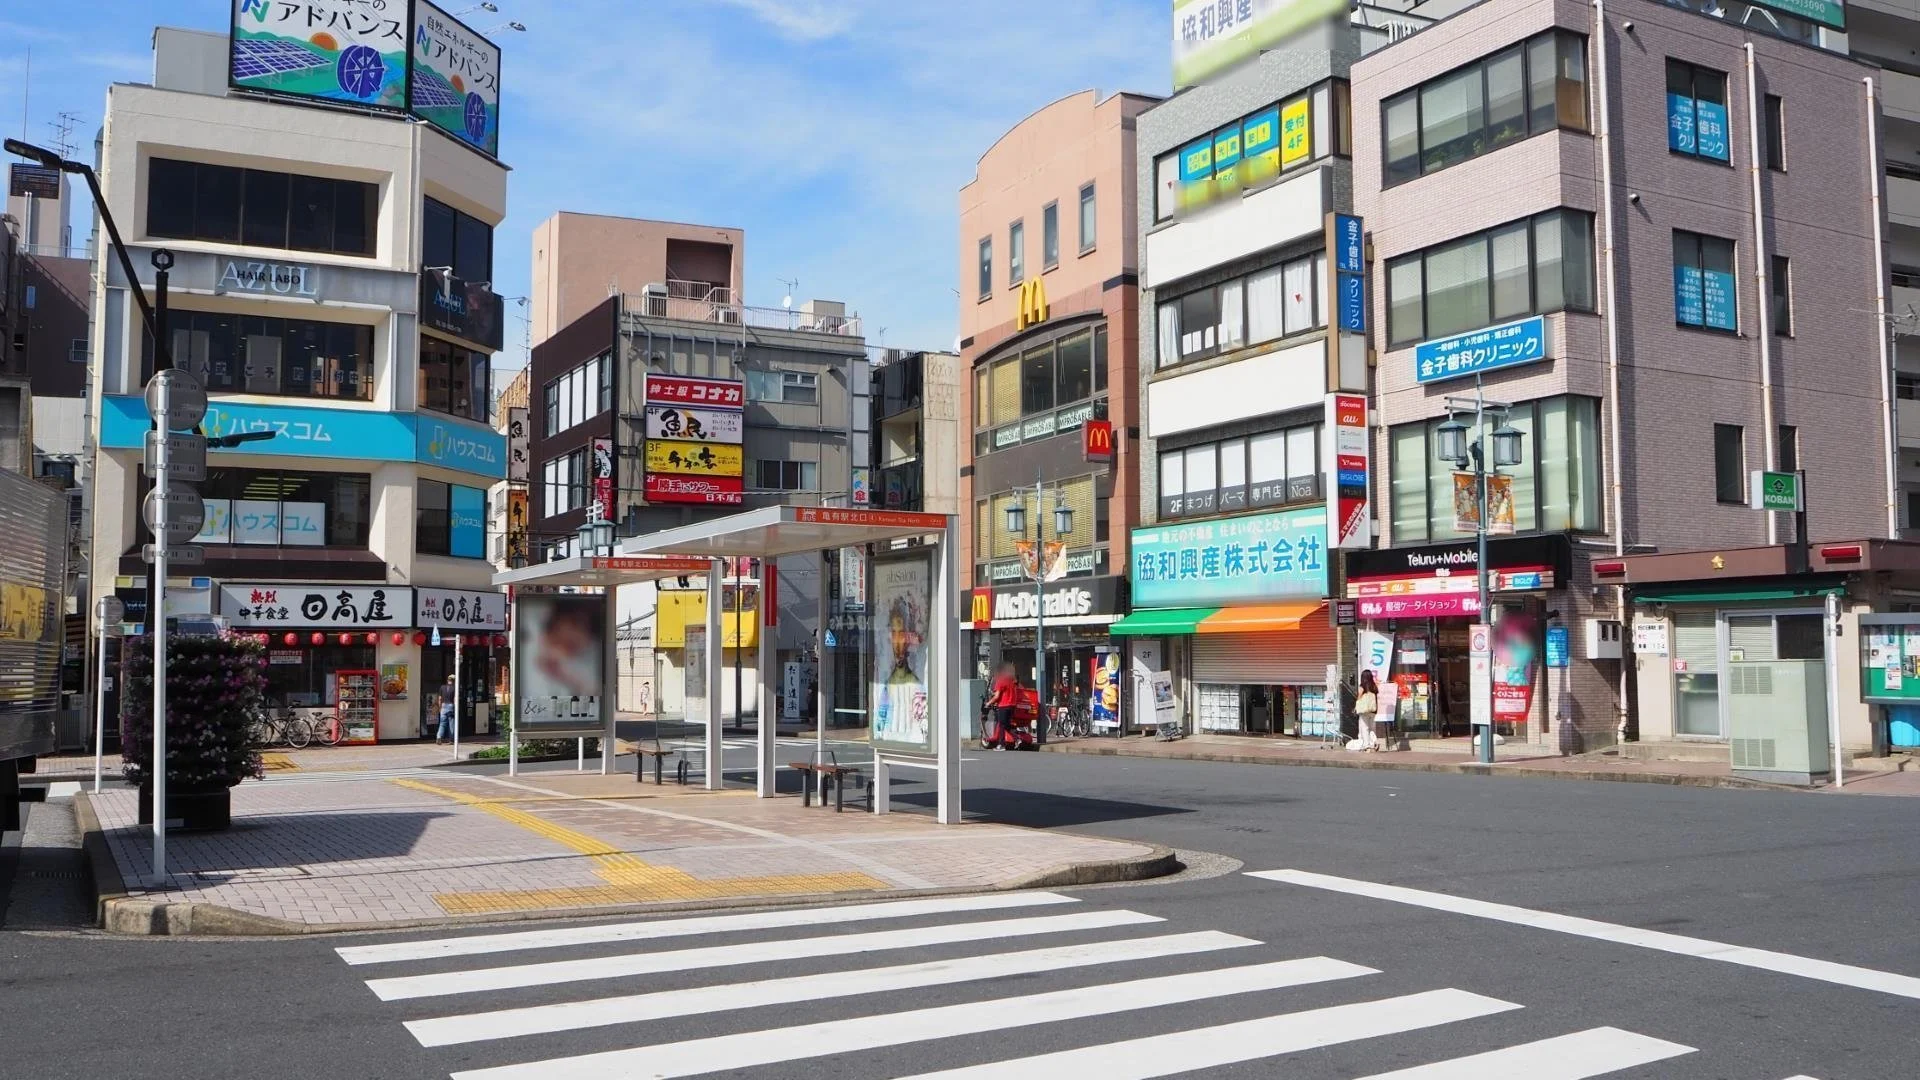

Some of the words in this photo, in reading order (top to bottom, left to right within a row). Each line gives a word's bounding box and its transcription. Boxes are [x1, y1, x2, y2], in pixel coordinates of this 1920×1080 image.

[277, 2, 404, 41] アドバンス
[1181, 0, 1252, 41] 協和興産
[426, 15, 489, 65] 自然エネルギーの
[434, 39, 497, 93] アドバンス
[1284, 115, 1306, 136] 受付
[1671, 114, 1721, 138] 金子歯科
[1288, 133, 1304, 150] 4F
[1678, 134, 1725, 154] クリニック
[217, 261, 319, 295] AZUL
[235, 269, 266, 282] HAIR
[1420, 336, 1538, 377] 金子歯科クリニック
[650, 384, 688, 397] 紳士服
[691, 386, 740, 402] コナカ
[229, 418, 331, 441] ハウスコム
[1343, 414, 1360, 424] au
[447, 436, 496, 463] ハウスコム
[1170, 500, 1183, 514] 2F
[1290, 484, 1313, 498] Noa
[1764, 494, 1795, 505] KOBAN
[222, 513, 318, 533] ハウスコム
[1137, 535, 1321, 582] 協和興産株式会社
[1407, 549, 1479, 567] Teluru+Mobile
[239, 604, 290, 626] 中華食堂
[301, 589, 393, 629] 日高屋
[1143, 651, 1152, 659] 2F
